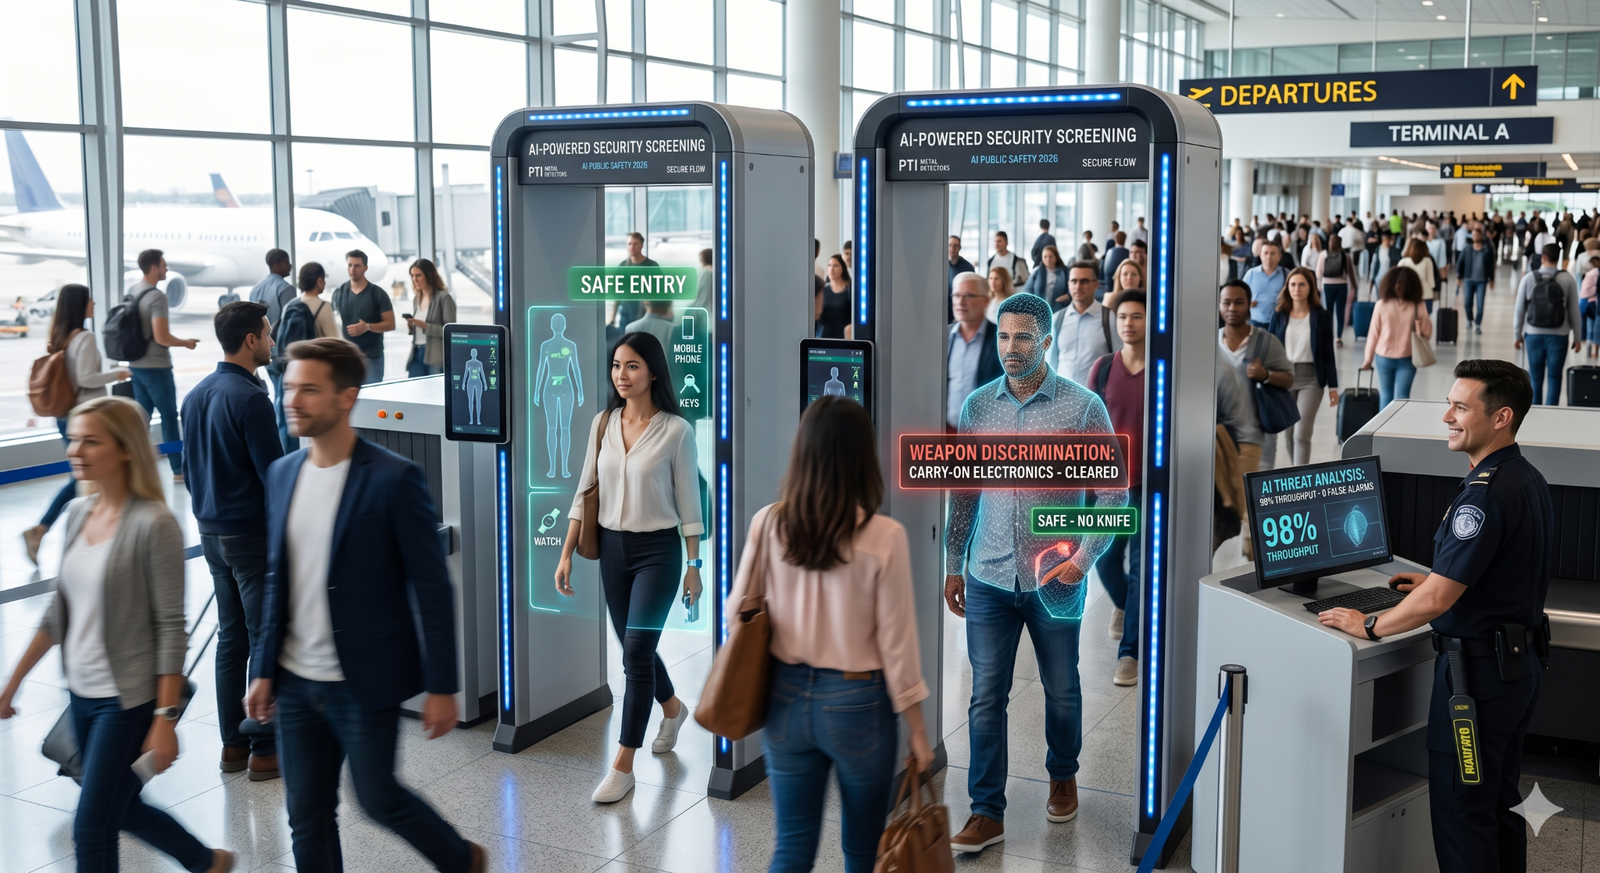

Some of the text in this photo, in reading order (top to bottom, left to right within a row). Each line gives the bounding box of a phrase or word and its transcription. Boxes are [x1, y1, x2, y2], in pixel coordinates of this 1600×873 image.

[1220, 80, 1377, 107] DEPARTURES
[900, 127, 1137, 147] AI-POWERED SECURITY SCREENING
[1388, 122, 1510, 142] TERMINAL A
[529, 138, 706, 156] AI-POWERED SECURITY SCREENING
[581, 160, 648, 170] AI PUBLIC SAFETY 2026
[898, 159, 918, 172] PTI
[970, 154, 1059, 165] AI PUBLIC SAFETY 2026
[1082, 157, 1137, 168] SECURE FLOW
[528, 166, 543, 177] PTI
[666, 164, 706, 174] SECURE FLOW
[1261, 467, 1366, 494] AI THREAT ANALYSIS:
[1259, 496, 1274, 507] 98%
[1275, 490, 1317, 504] THROUGHPUT
[1327, 485, 1347, 496] FALSE
[1347, 482, 1374, 494] ALARMS
[1262, 511, 1317, 548] 98%
[1266, 544, 1319, 562] THROUGHPUT
